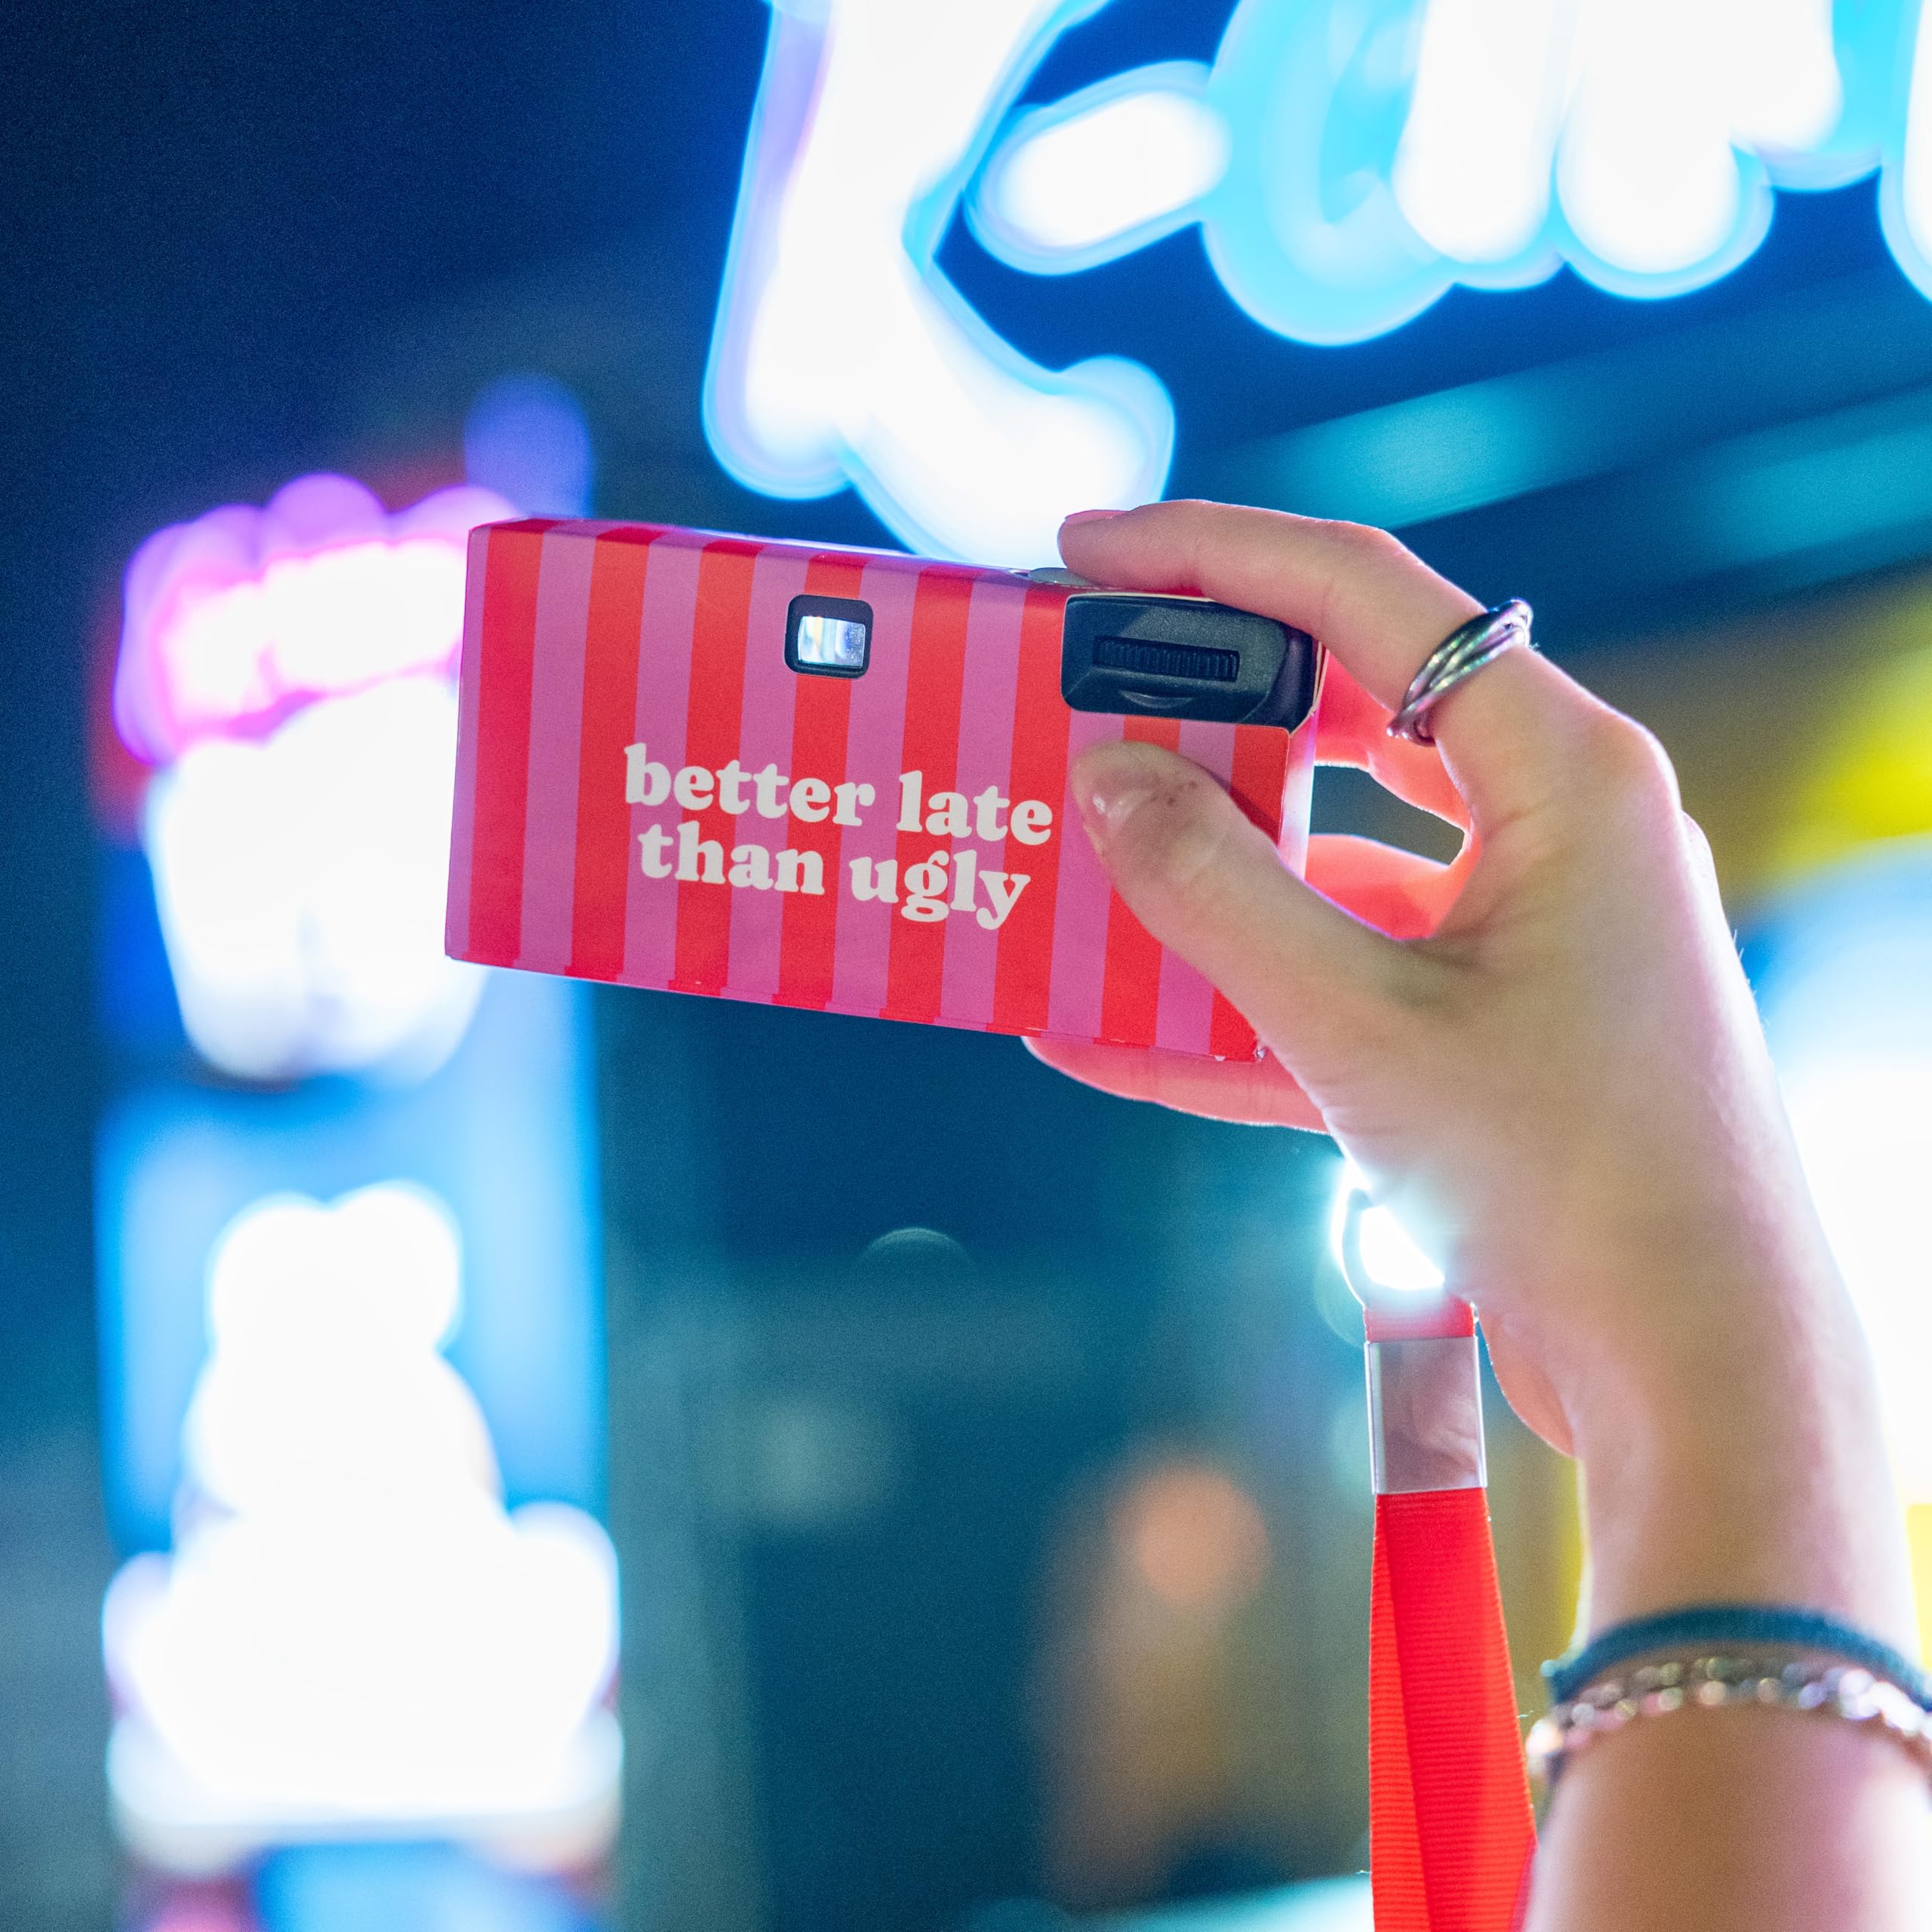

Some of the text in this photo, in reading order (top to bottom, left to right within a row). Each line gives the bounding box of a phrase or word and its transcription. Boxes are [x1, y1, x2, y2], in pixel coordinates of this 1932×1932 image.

[625, 743, 1052, 844] better late
[638, 821, 1030, 930] than ugly
